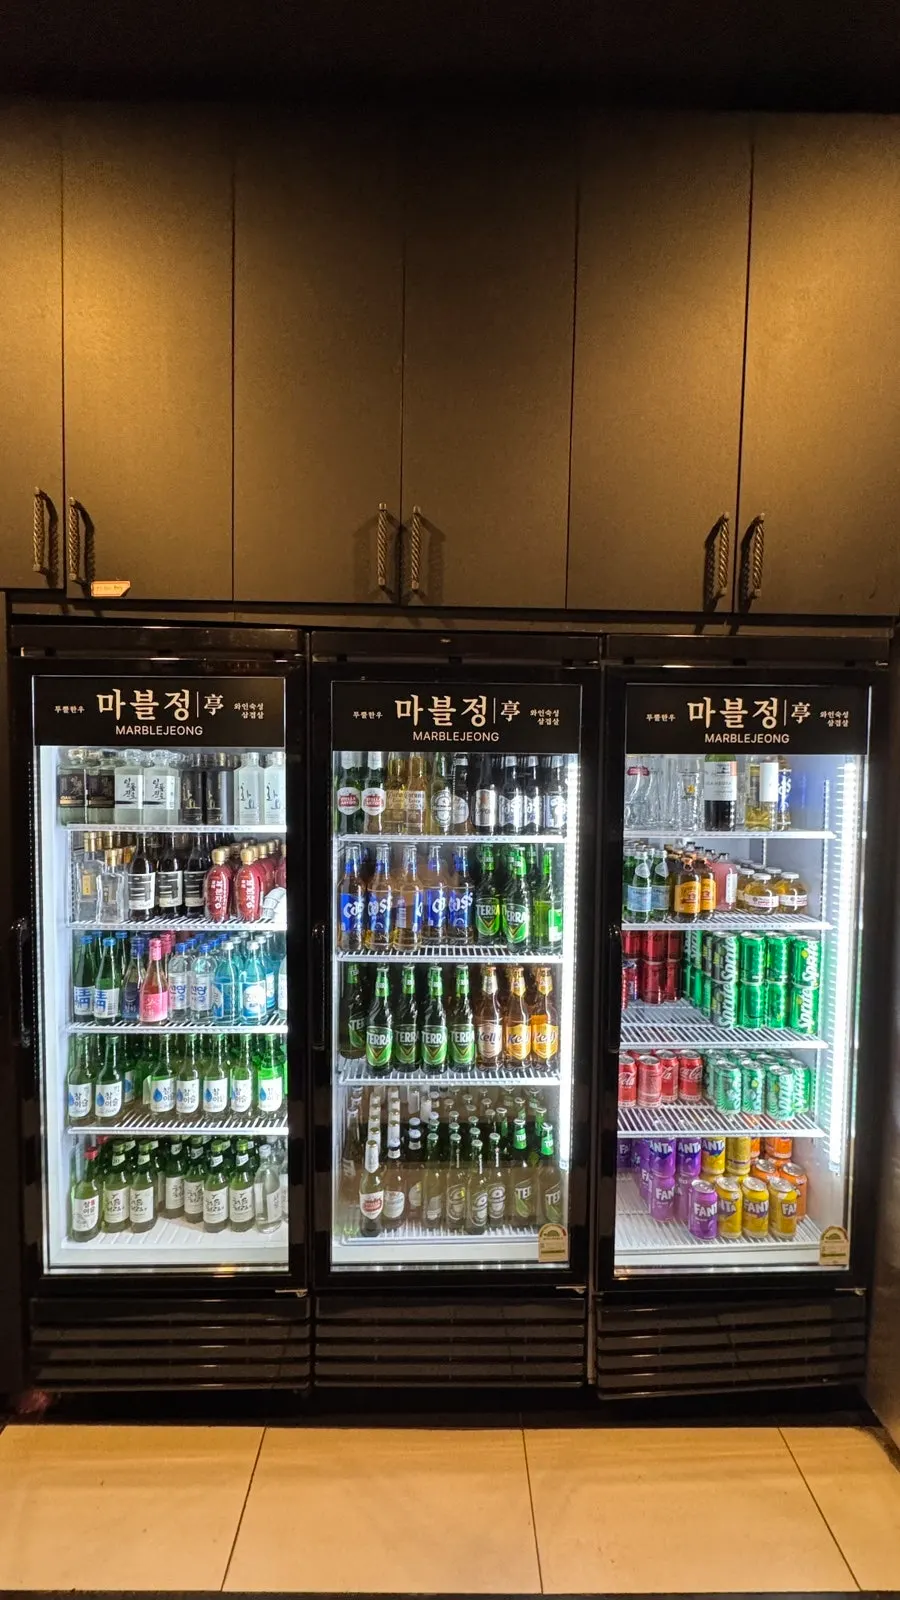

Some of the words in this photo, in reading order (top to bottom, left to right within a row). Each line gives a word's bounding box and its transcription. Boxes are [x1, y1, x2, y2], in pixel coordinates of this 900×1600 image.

[96, 688, 190, 721] 마블정
[203, 694, 224, 716] 亭
[234, 702, 264, 711] 와인숙성
[241, 711, 265, 720] 삼겹살
[394, 694, 488, 727] 마블정
[500, 700, 521, 722] 亭
[530, 709, 560, 718] 와인숙성
[687, 696, 778, 729] 마블정
[791, 702, 812, 724] 亭
[820, 710, 849, 719] 와인숙성
[537, 717, 560, 726] 삼겹살
[827, 719, 849, 727] 삼겹살
[115, 725, 203, 736] MARBLEJEONG
[412, 731, 500, 742] MARBLEJEONG
[704, 733, 790, 744] MARBLEJEONG
[476, 904, 500, 916] TERRA
